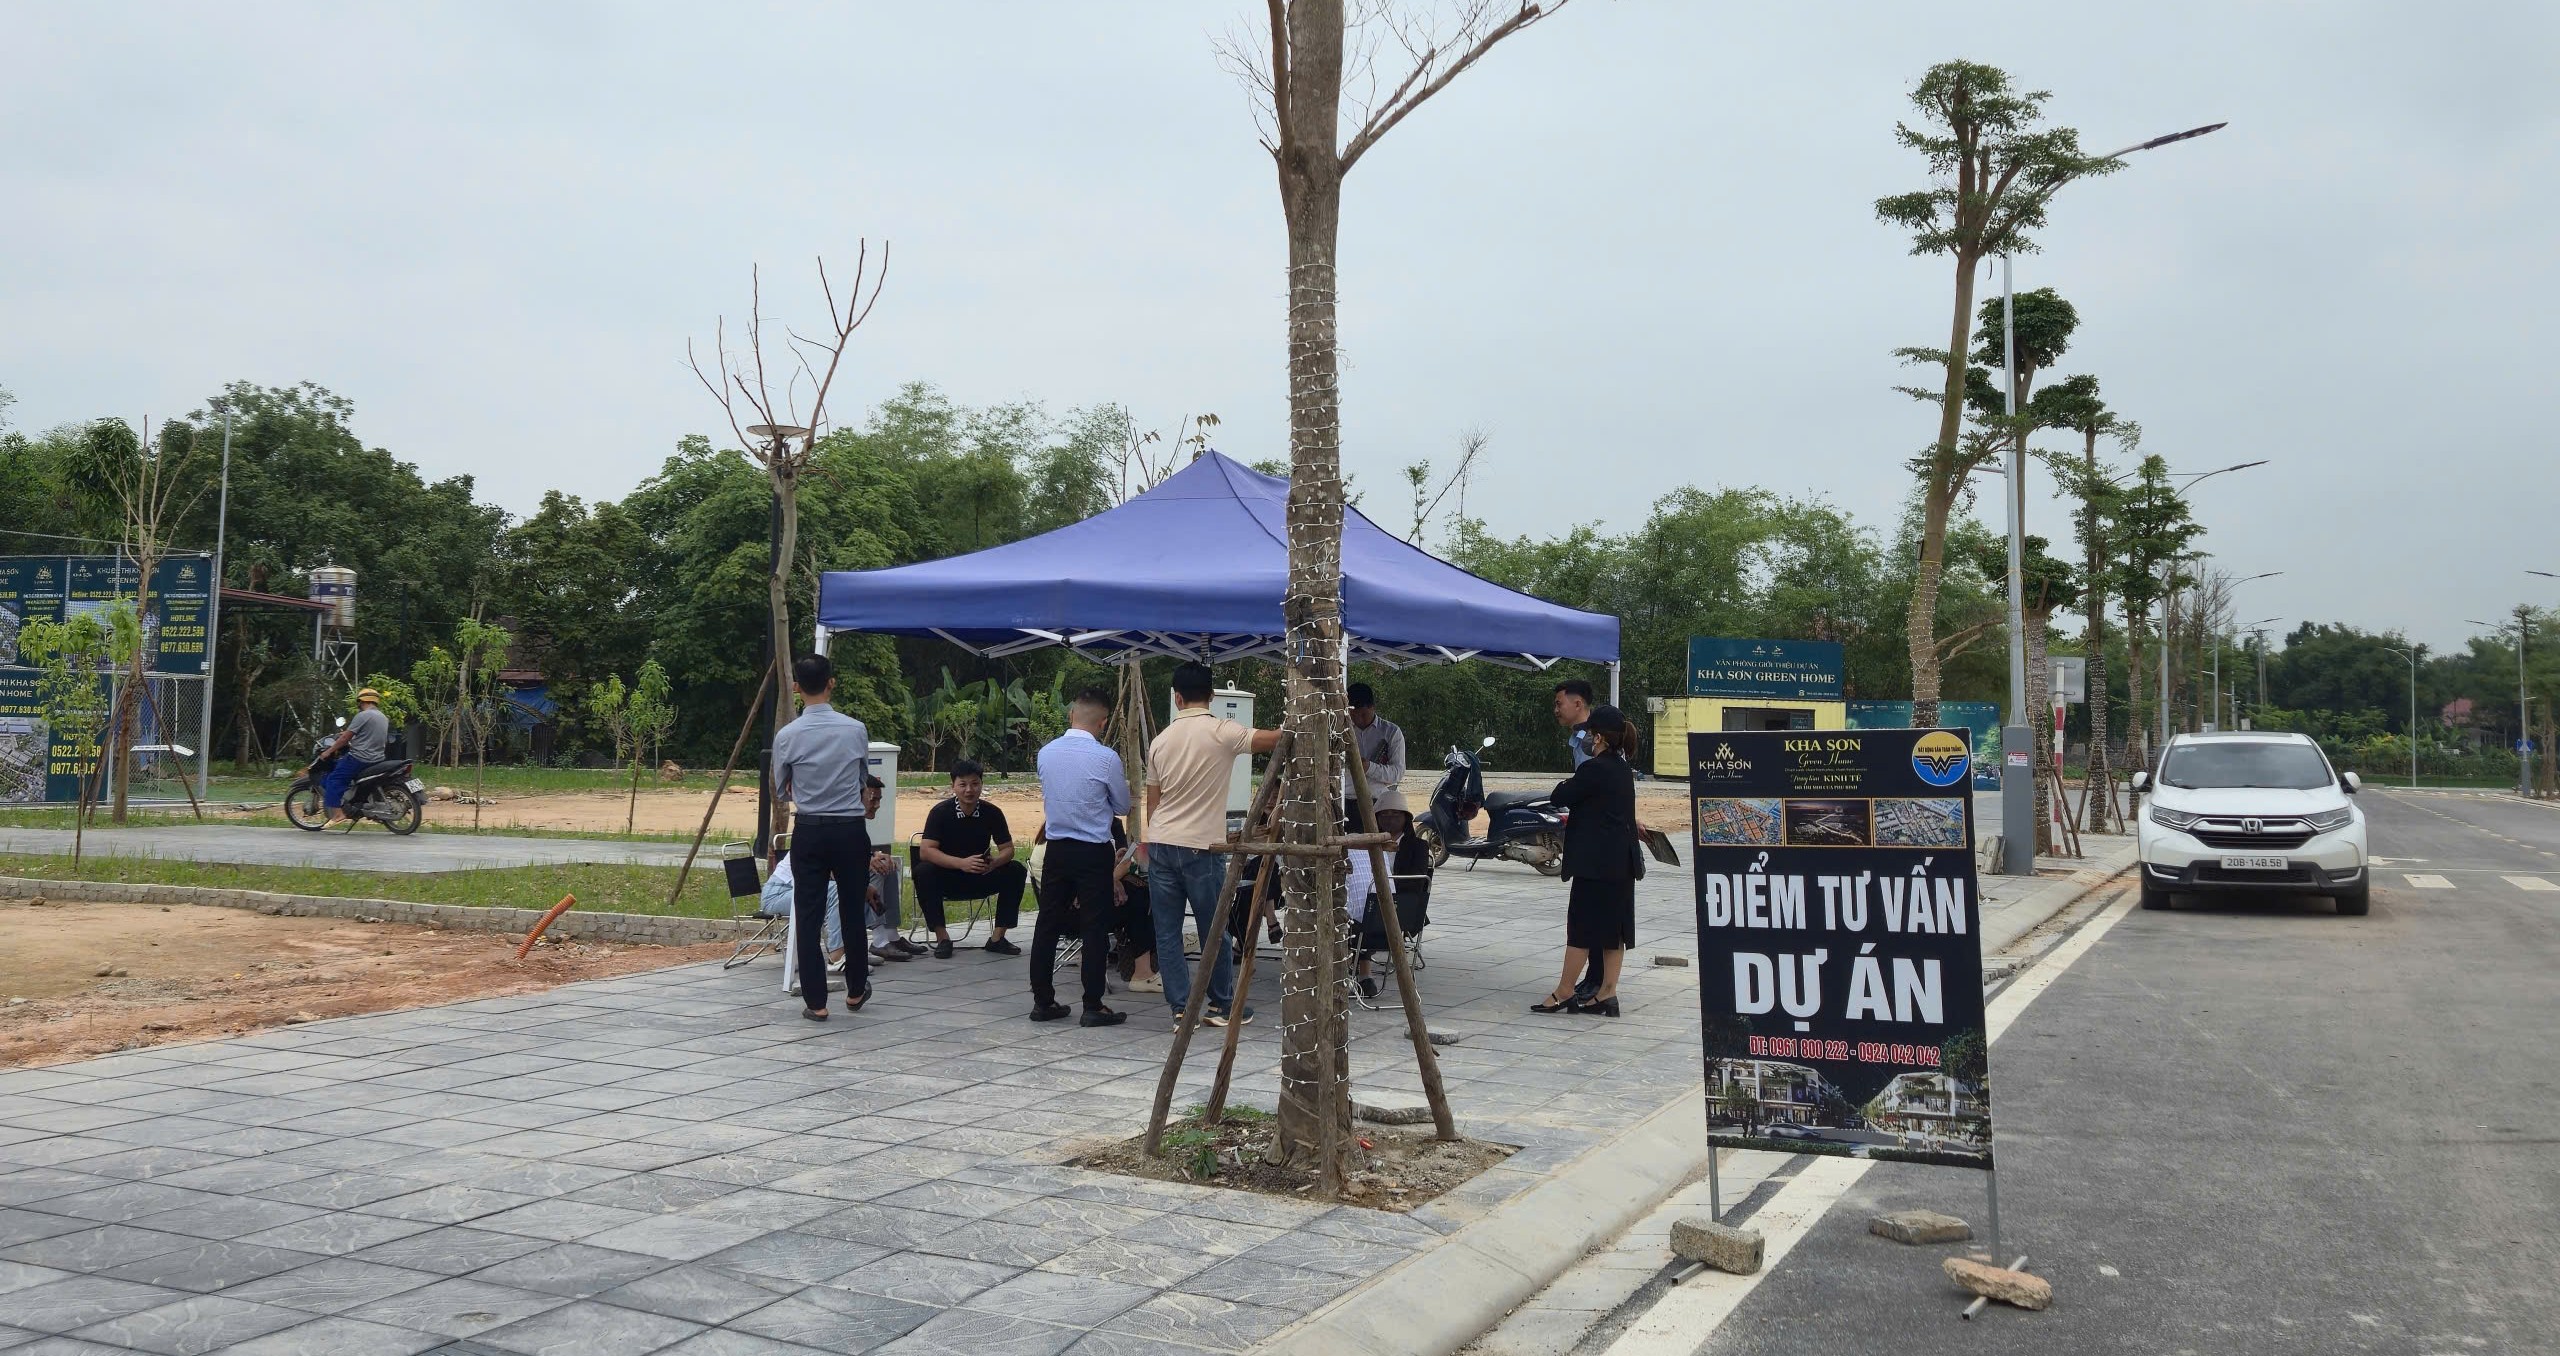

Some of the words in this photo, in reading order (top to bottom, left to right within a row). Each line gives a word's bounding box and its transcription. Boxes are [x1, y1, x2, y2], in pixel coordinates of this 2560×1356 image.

[170, 614, 197, 622] HOTLINE
[0, 679, 9, 688] HỊ
[10, 679, 29, 687] KHA
[1697, 669, 1724, 680] KHA
[1727, 669, 1753, 681] SƠN
[1755, 671, 1797, 682] GREEN
[1800, 673, 1836, 684] HOME
[6, 690, 33, 698] HOME
[1784, 739, 1822, 752] KHA
[1826, 738, 1862, 751] SƠN
[1699, 760, 1724, 770] KHA
[1726, 758, 1752, 770] SƠN
[1798, 752, 1822, 768] Green
[1823, 750, 1854, 766] Home
[1705, 851, 1807, 930] ĐIỂM
[1818, 870, 1872, 932] TƯ
[1879, 856, 1967, 934] VẤN
[1733, 948, 1828, 1032] DỰ
[1845, 942, 1944, 1024] ÁN
[1769, 1036, 1798, 1058] 0961
[1800, 1038, 1824, 1059] 800
[1825, 1040, 1849, 1061] 222
[1857, 1041, 1889, 1063] 0924
[1890, 1043, 1915, 1065] 042
[1916, 1045, 1941, 1067] 042
